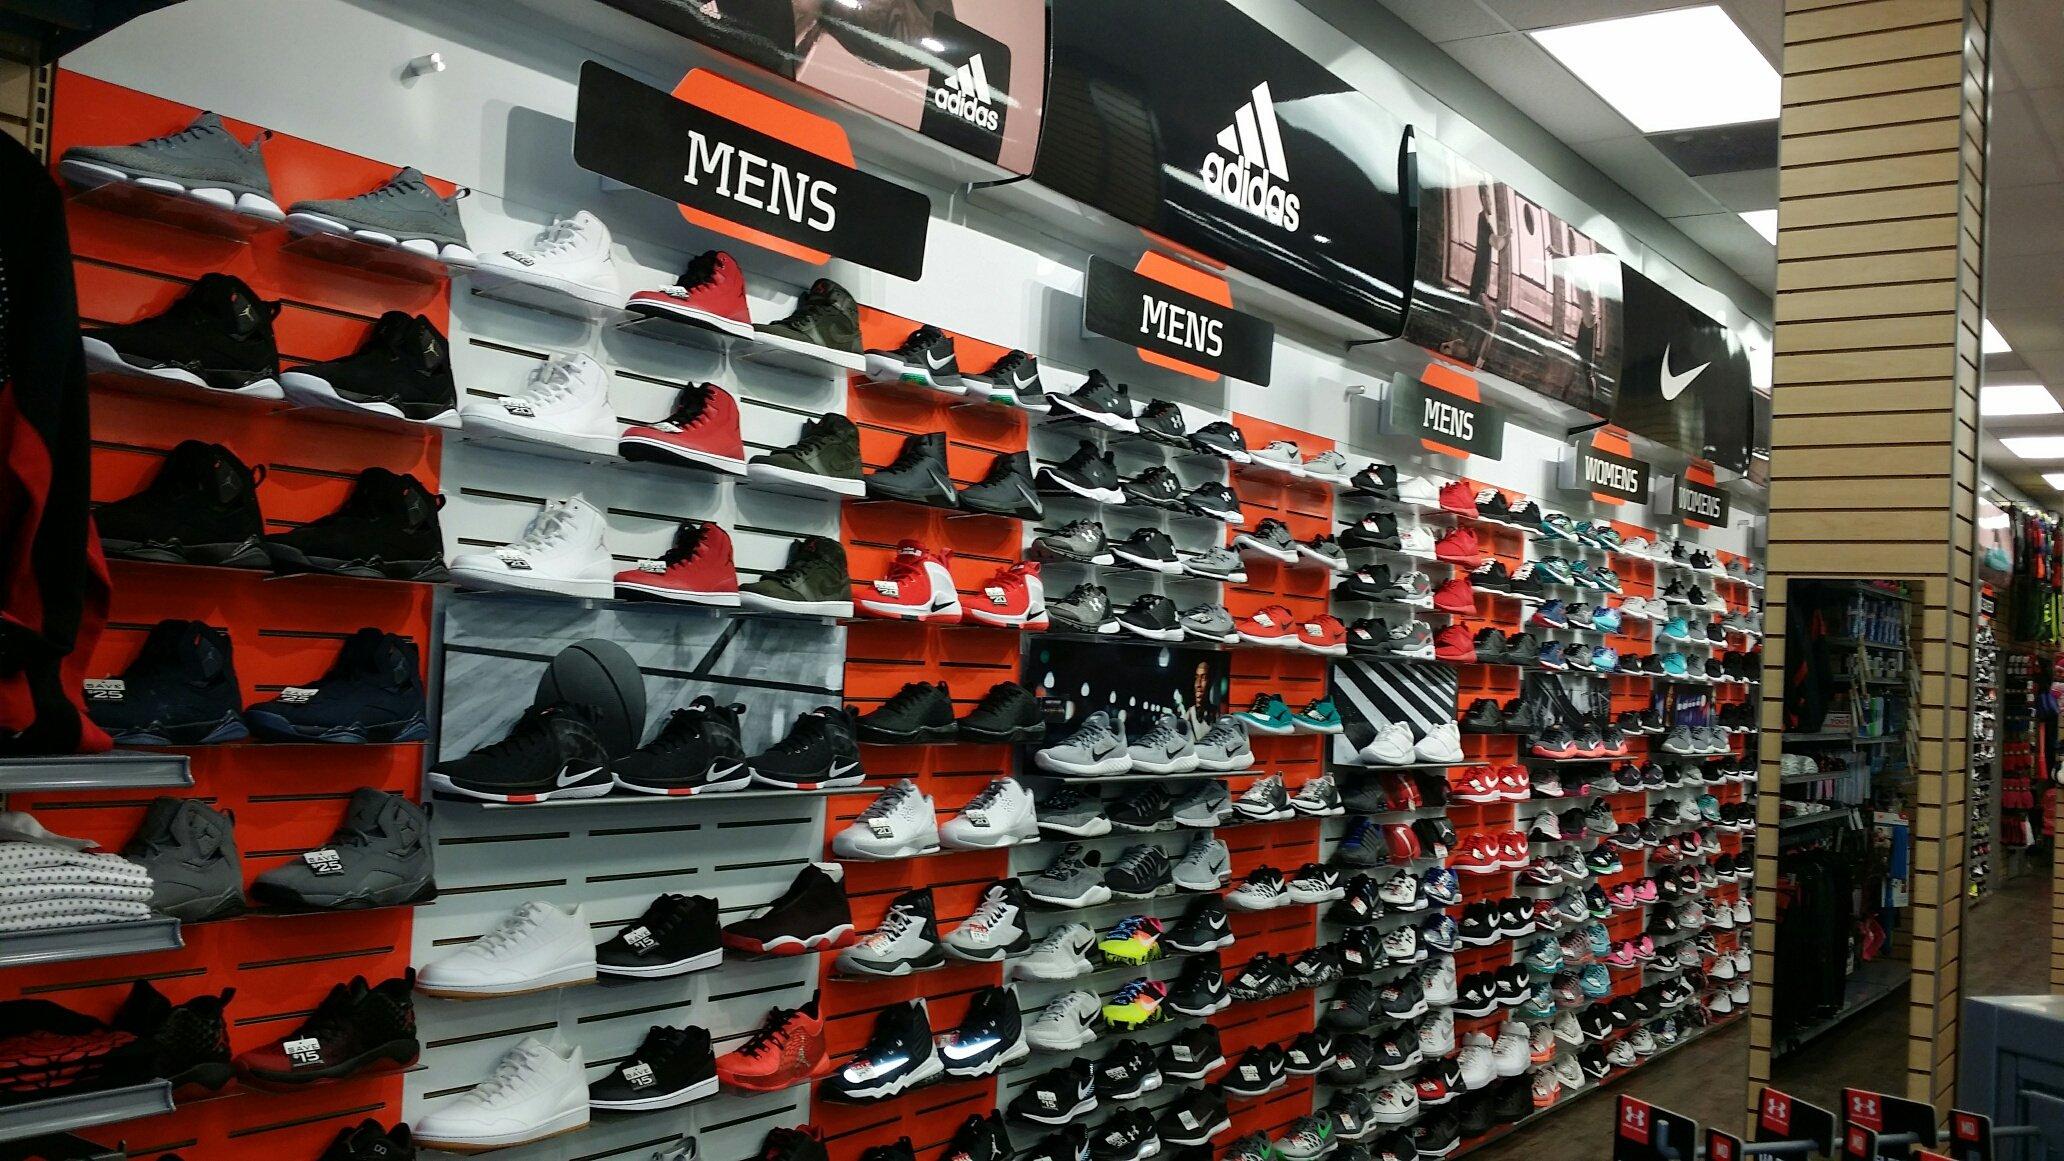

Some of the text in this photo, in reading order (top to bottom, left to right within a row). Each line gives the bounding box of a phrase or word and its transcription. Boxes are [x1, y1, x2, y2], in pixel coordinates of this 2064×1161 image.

[935, 87, 999, 131] adidas
[684, 130, 838, 232] MENS
[1202, 151, 1301, 232] adidas
[1141, 294, 1224, 357] MENS
[1423, 397, 1475, 441] MENS
[1584, 455, 1638, 493] WOMENS
[1678, 487, 1721, 518] WOMENS
[308, 855, 338, 863] SAVE
[287, 1044, 319, 1053] SAVE
